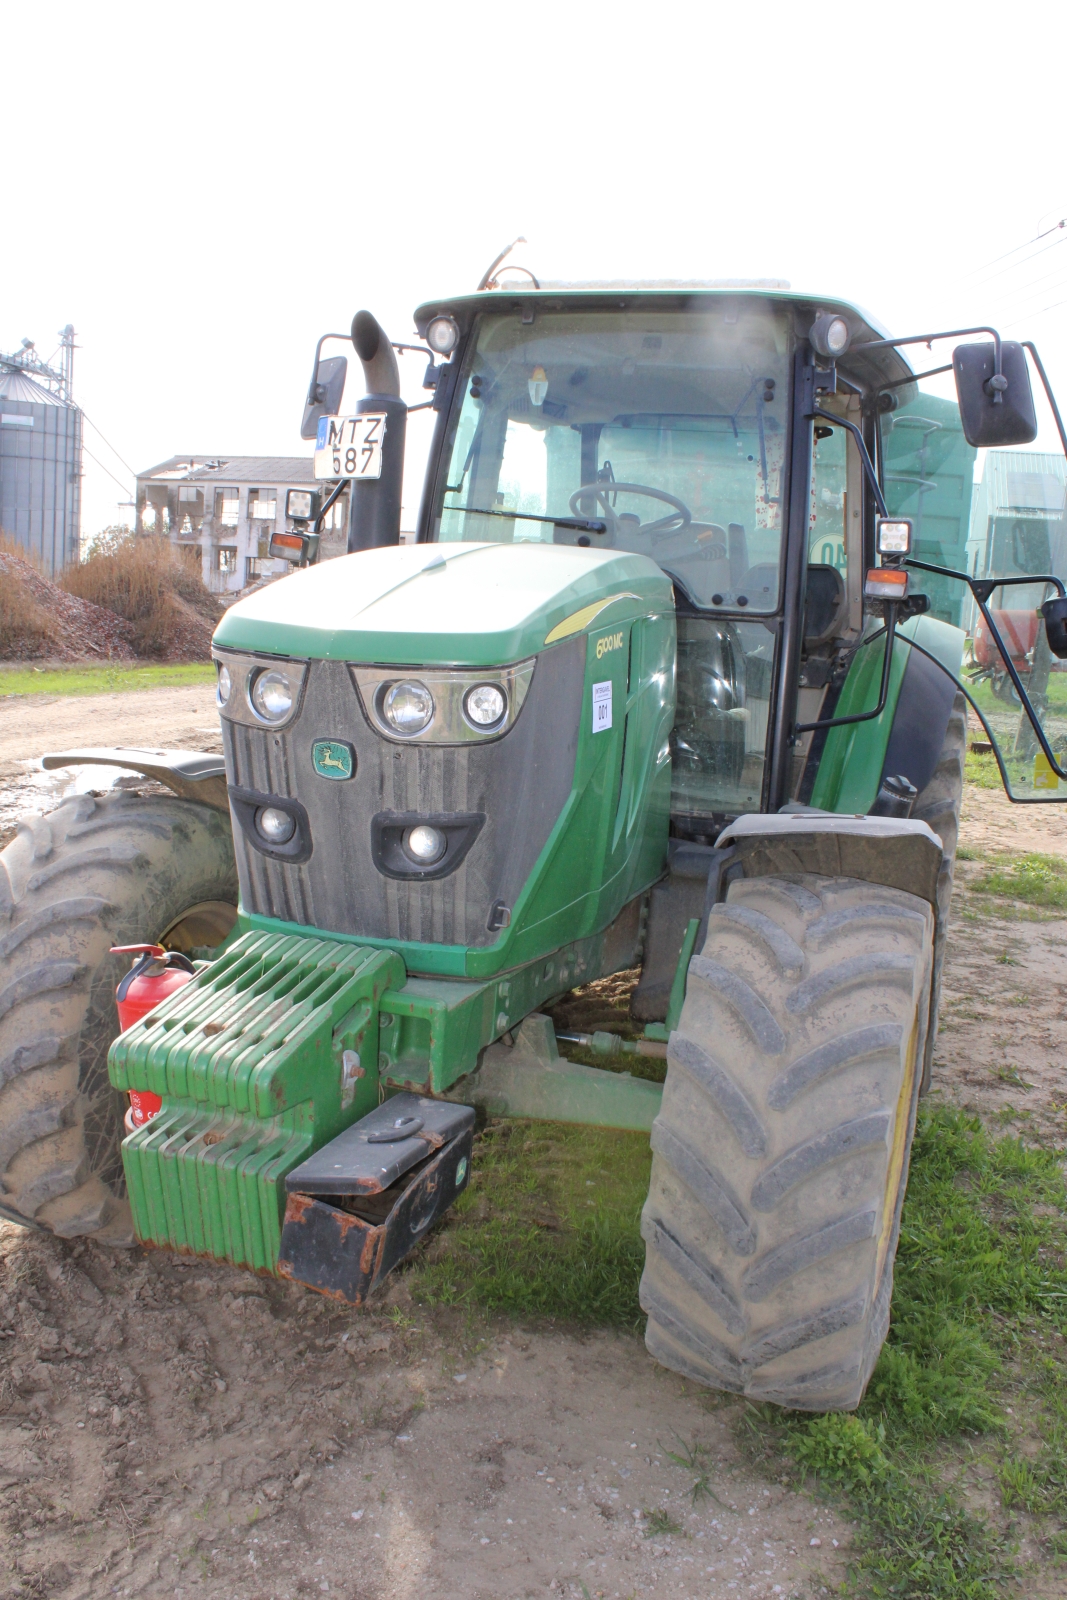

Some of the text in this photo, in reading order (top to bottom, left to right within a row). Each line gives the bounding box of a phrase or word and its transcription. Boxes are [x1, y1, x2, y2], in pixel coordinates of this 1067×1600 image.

[318, 437, 325, 446] H
[328, 418, 381, 445] MTZ
[333, 447, 374, 474] 587
